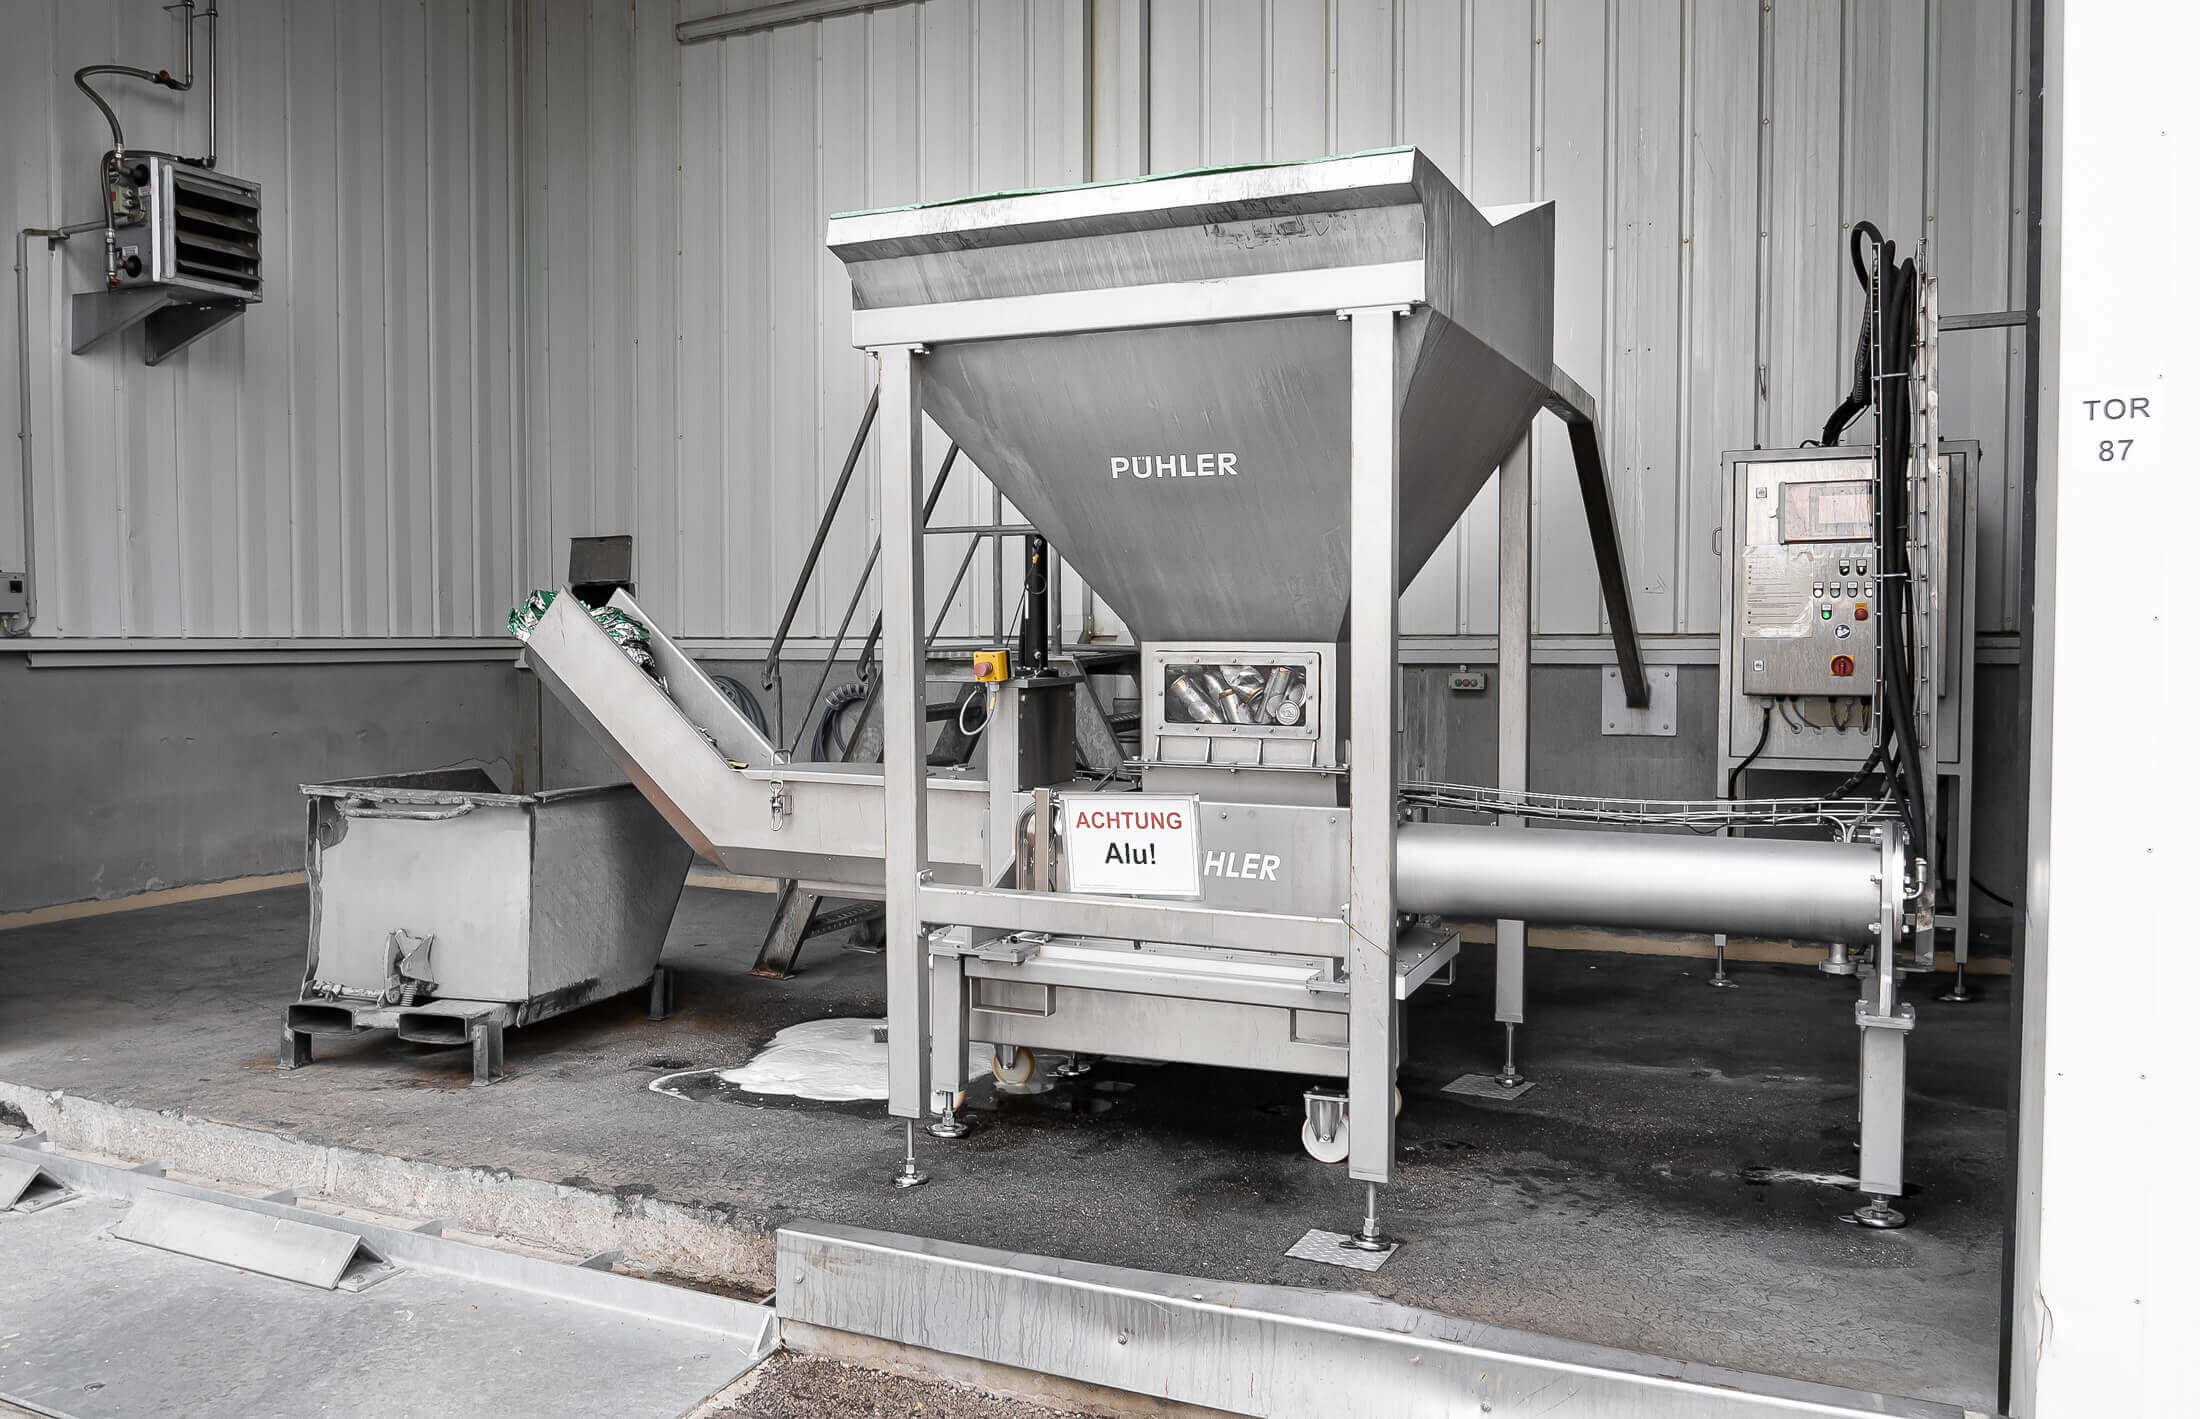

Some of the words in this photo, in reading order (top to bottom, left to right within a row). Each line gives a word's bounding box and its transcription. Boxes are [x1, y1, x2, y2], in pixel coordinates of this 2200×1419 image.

[2083, 397, 2151, 421] TOR
[2098, 439, 2134, 462] 87
[1110, 453, 1239, 479] PÜHLER
[1076, 811, 1182, 830] ACHTUNG
[1105, 842, 1156, 865] Alu!
[1204, 850, 1281, 881] HLER
